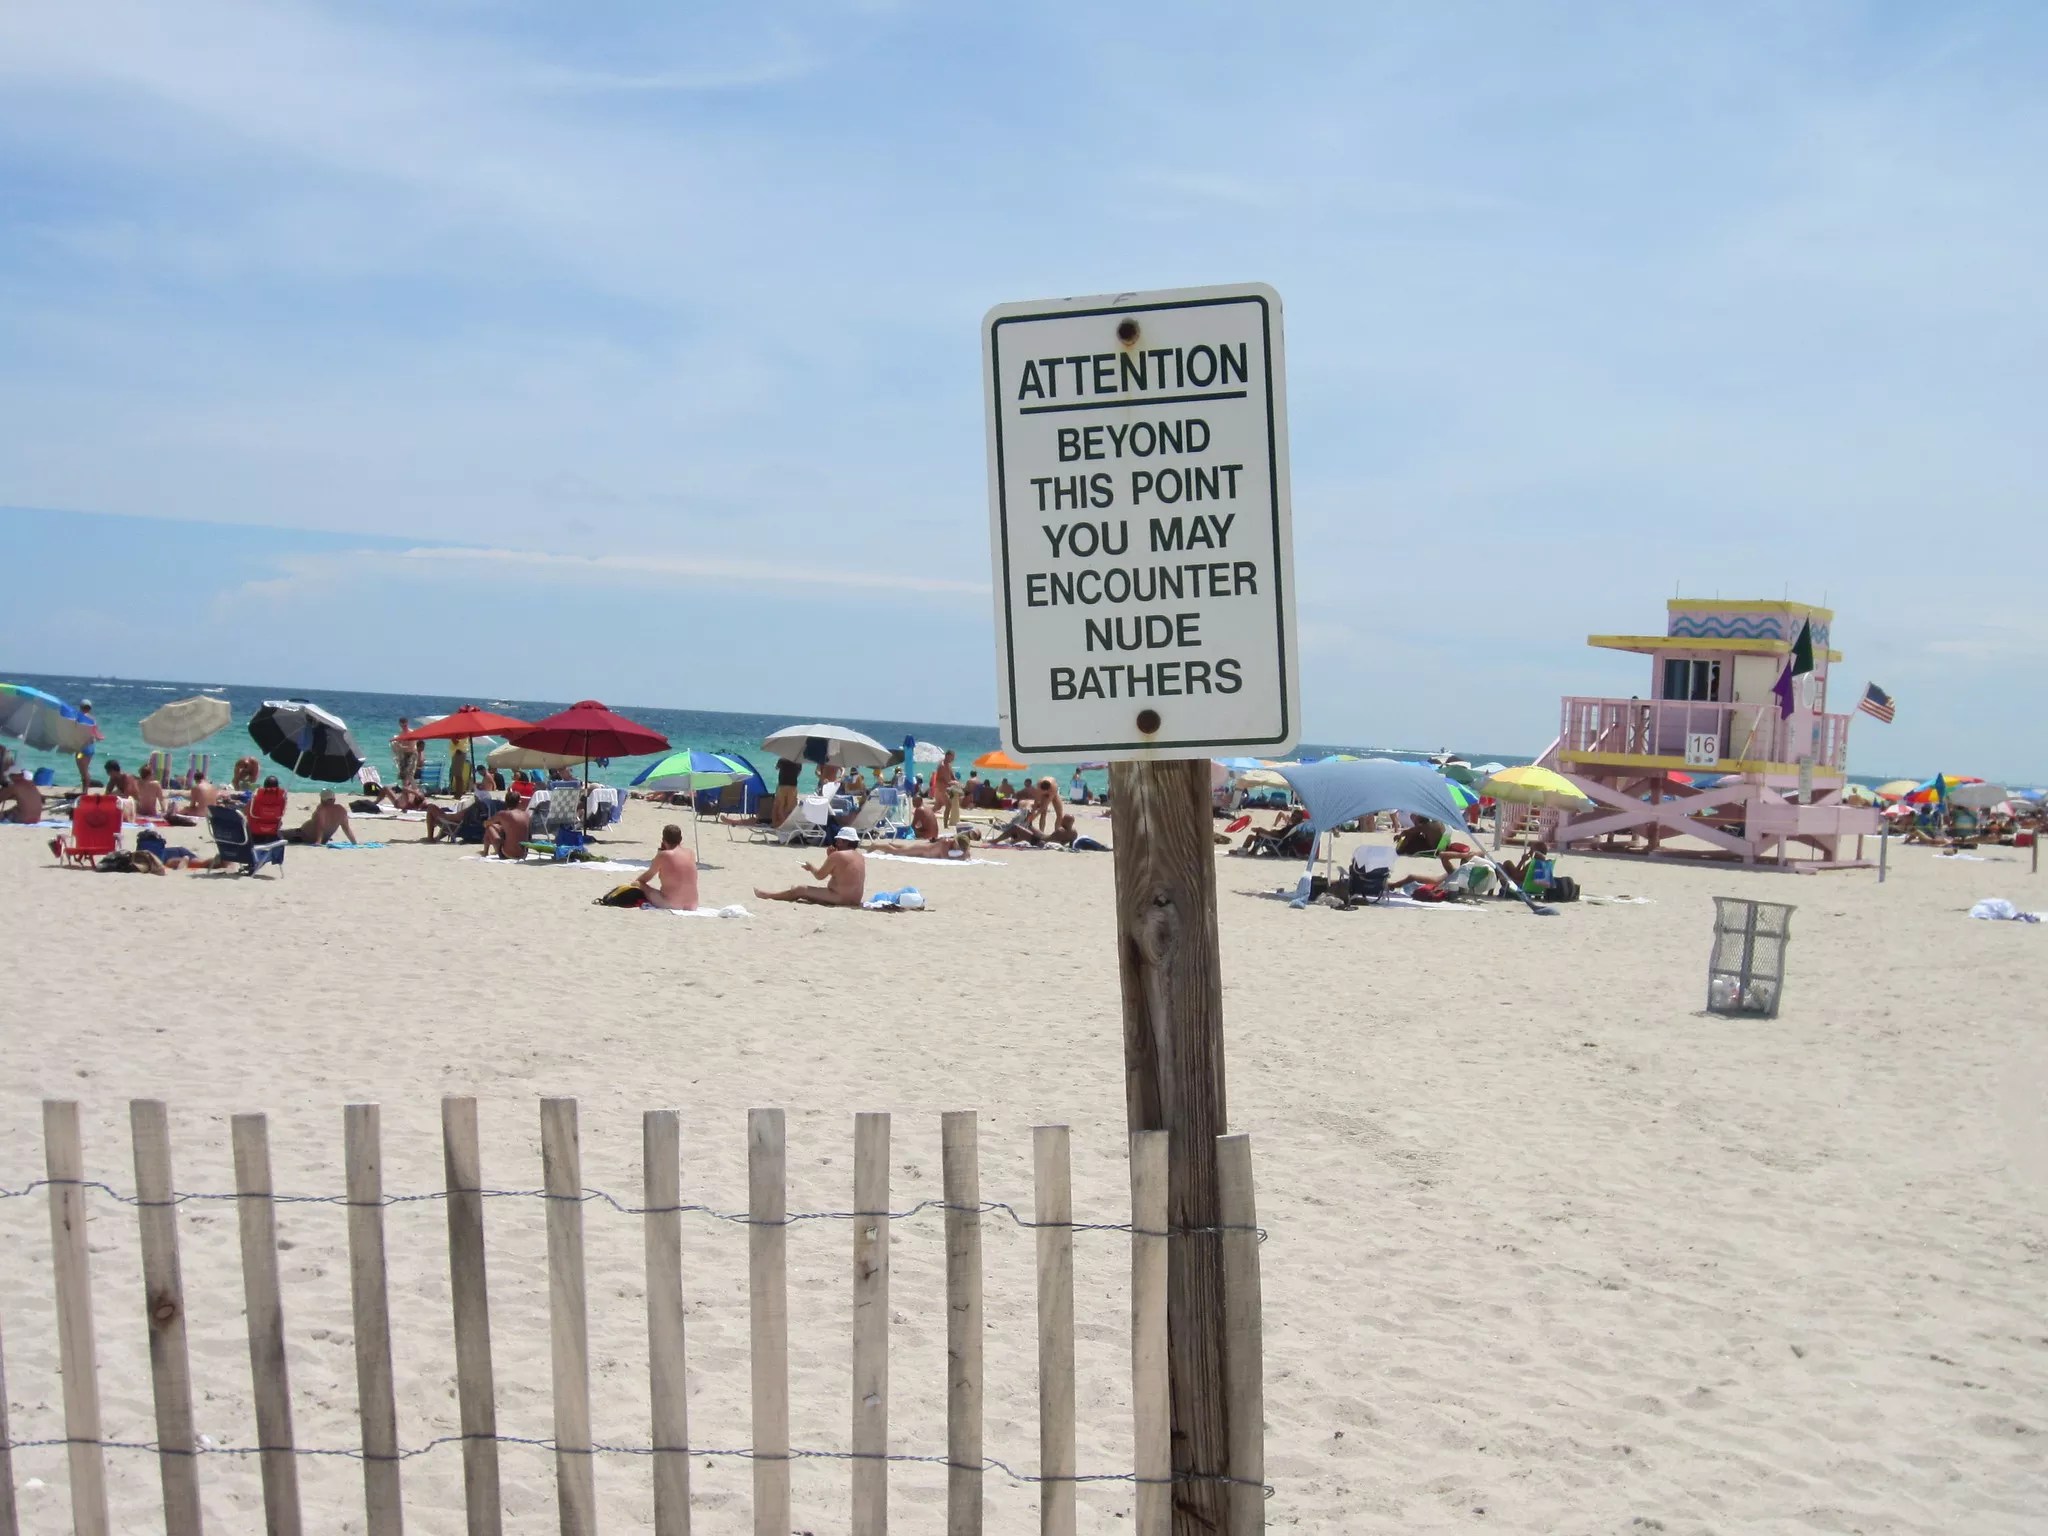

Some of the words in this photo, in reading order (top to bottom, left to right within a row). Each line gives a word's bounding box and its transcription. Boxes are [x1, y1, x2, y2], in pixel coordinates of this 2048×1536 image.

[1018, 342, 1248, 400] ATTENTION
[1058, 419, 1210, 462] BEYOND
[1031, 473, 1113, 511] THIS
[1132, 464, 1243, 505] POINT
[1042, 521, 1128, 558] YOU
[1150, 514, 1235, 552] MAY
[1027, 562, 1257, 607] ENCOUNTER
[1086, 613, 1201, 651] NUDE
[1051, 659, 1242, 700] BATHERS
[1694, 736, 1715, 753] 16
